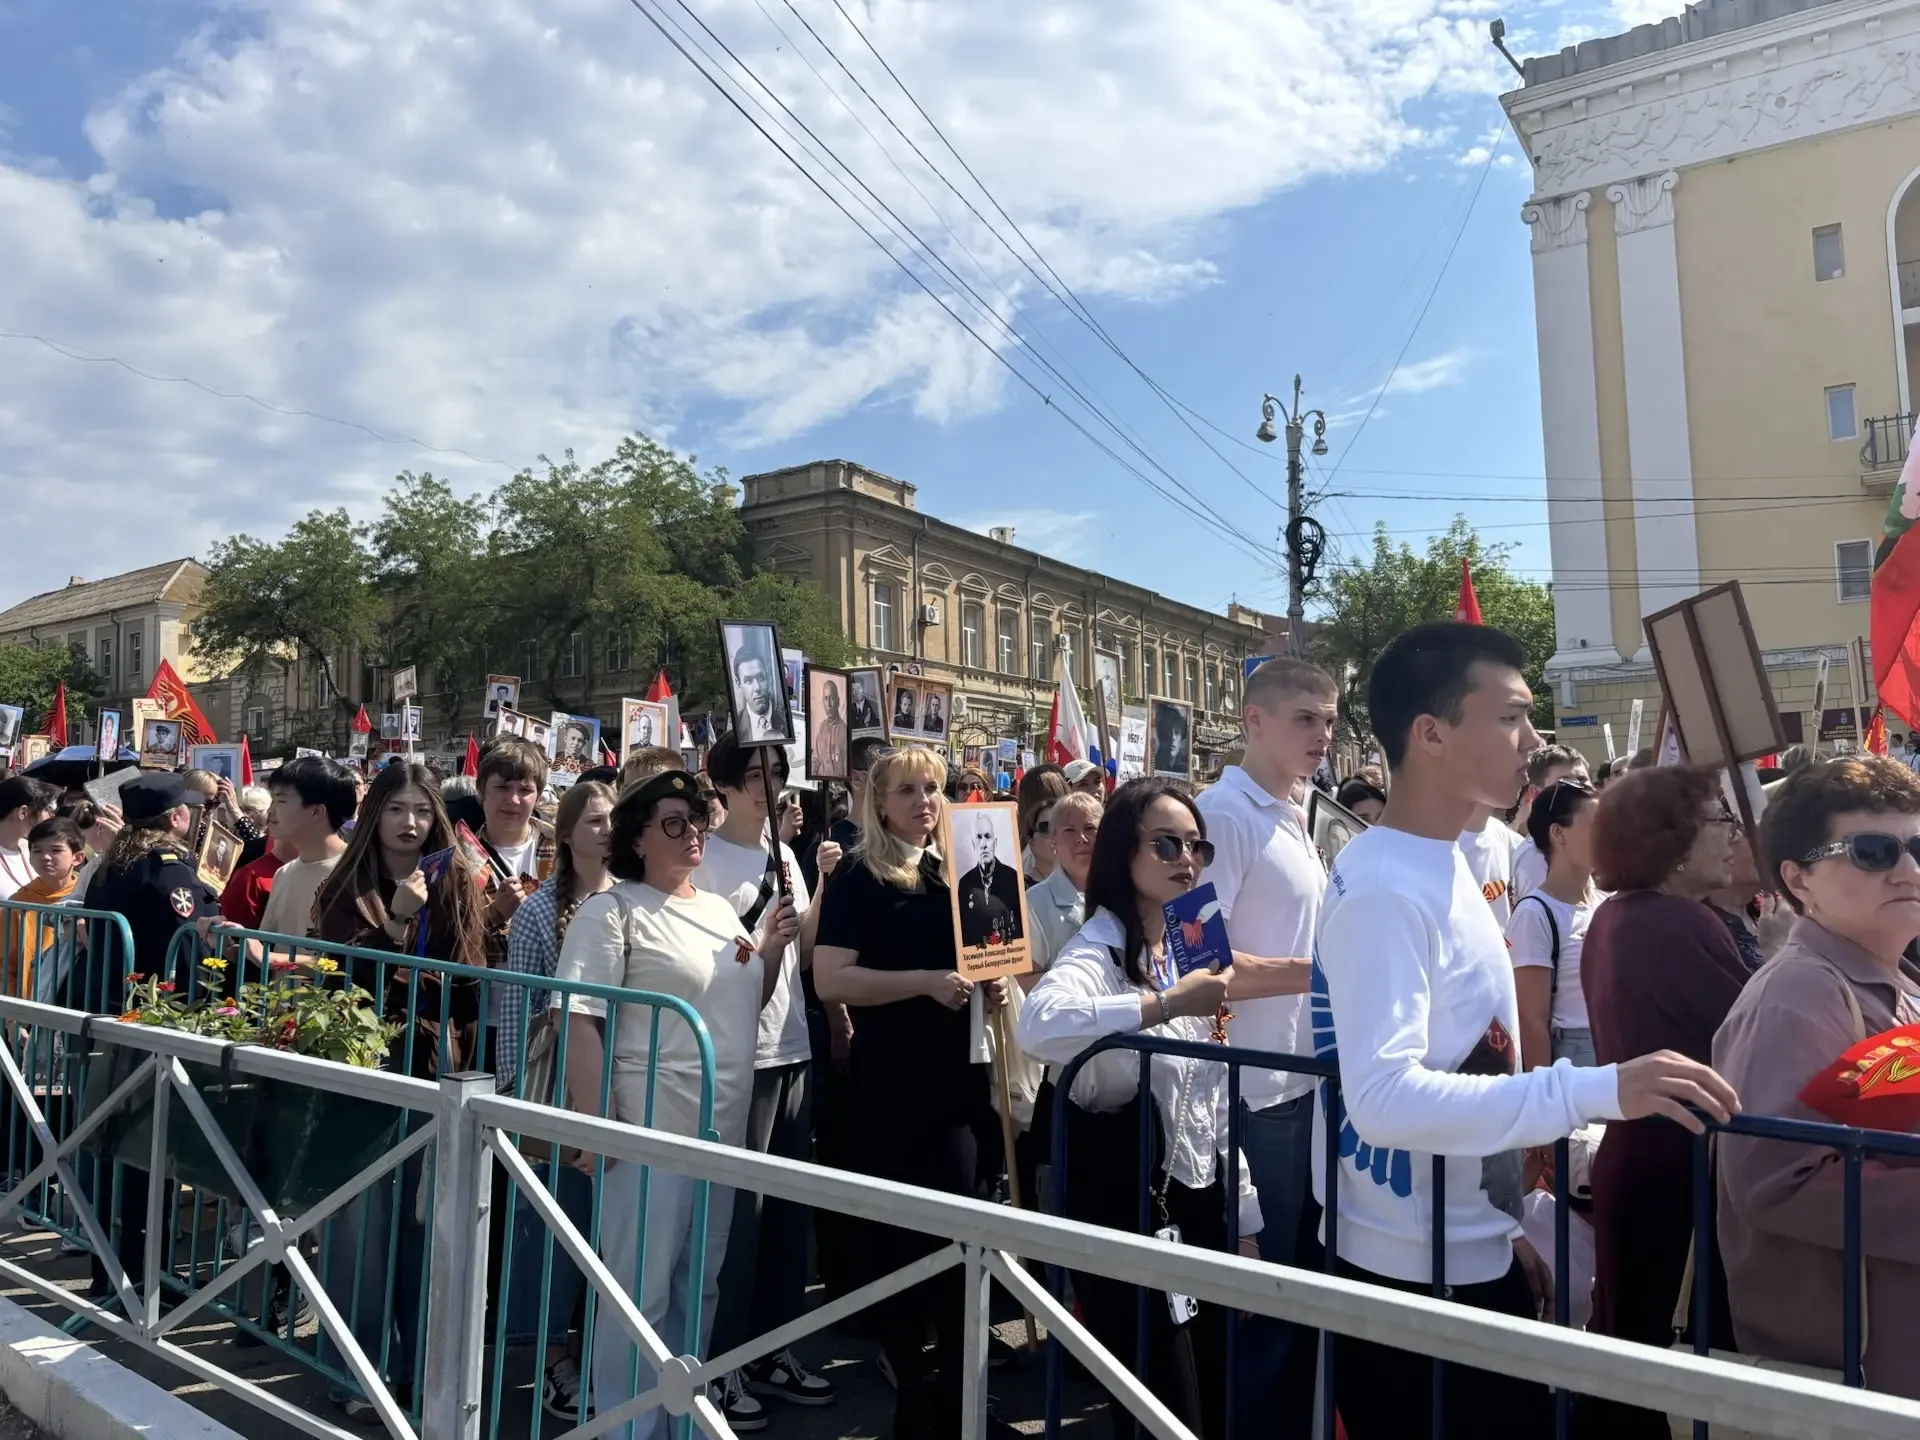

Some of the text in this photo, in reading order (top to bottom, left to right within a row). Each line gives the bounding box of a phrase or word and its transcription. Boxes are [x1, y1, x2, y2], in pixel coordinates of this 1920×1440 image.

[985, 948, 1006, 956] Александр
[967, 956, 1023, 971] Первый Белорусский фронт
